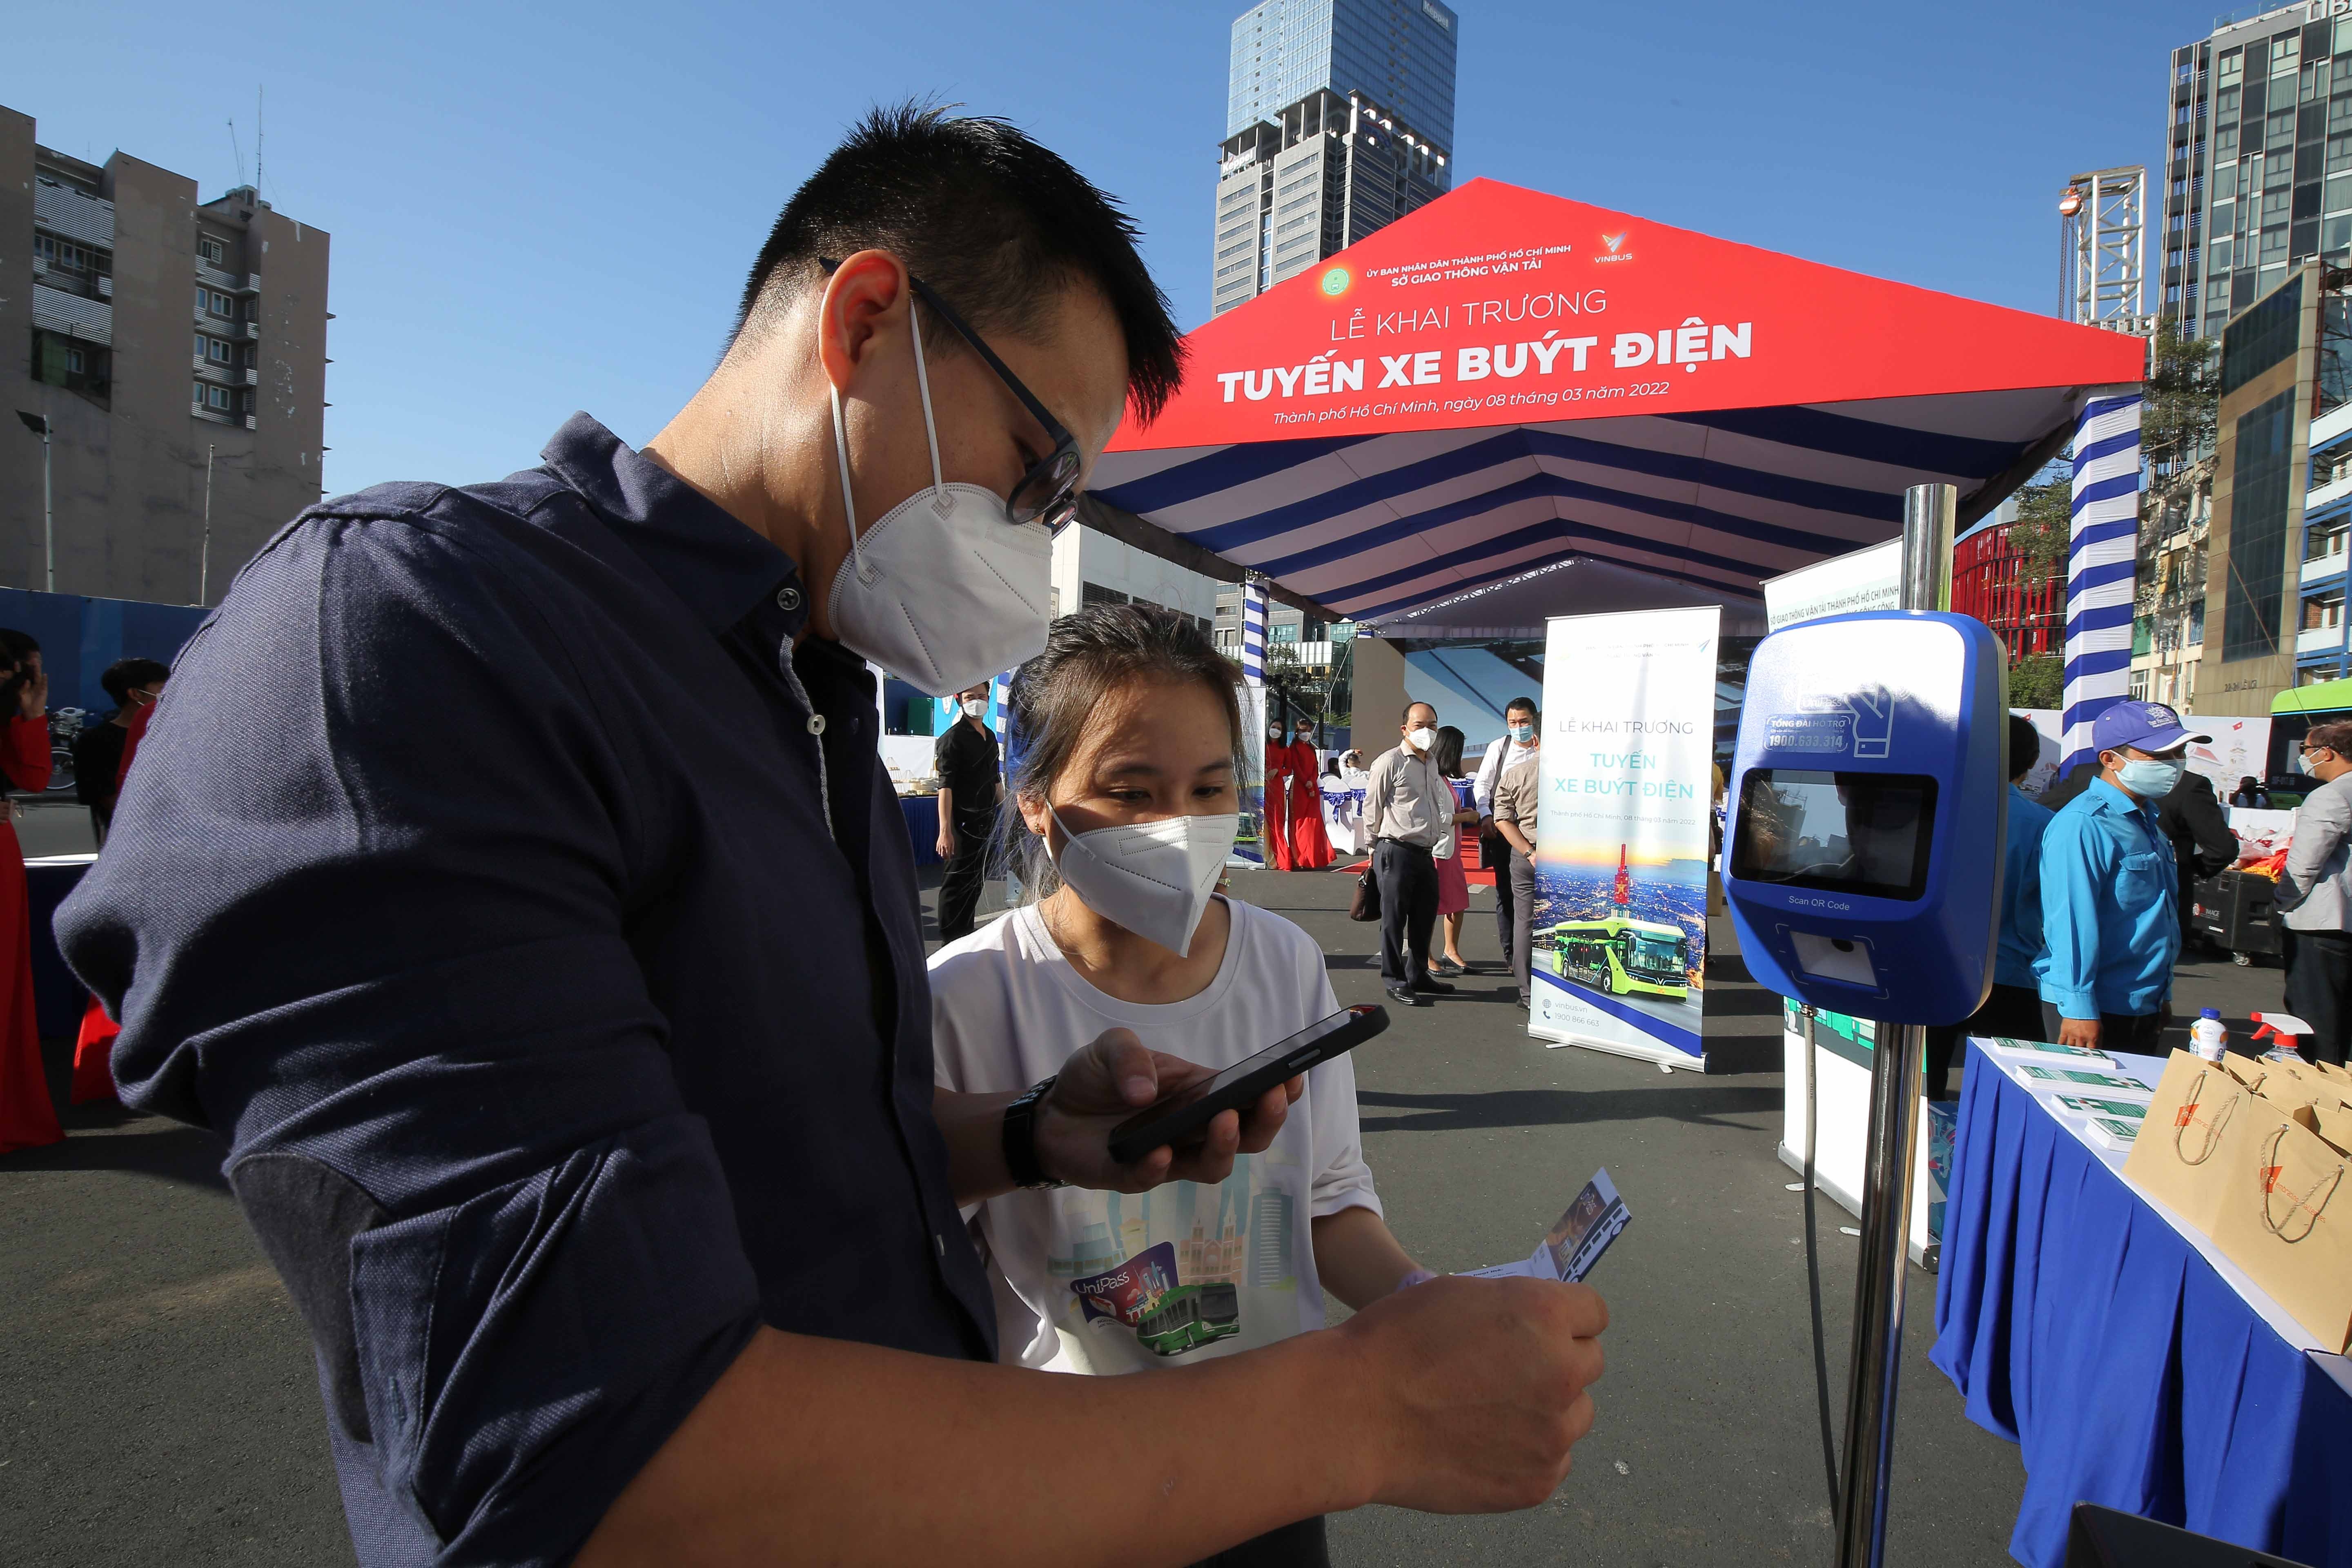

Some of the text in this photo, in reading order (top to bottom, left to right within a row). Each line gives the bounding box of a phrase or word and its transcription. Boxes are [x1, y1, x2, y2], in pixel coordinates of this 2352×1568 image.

[2305, 0, 2352, 24] LIB
[1223, 149, 1253, 173] Keppel
[1366, 244, 1571, 278] ỦY BAN NHÂN DÂN THÀNH PHỐ HỒ CHÍ MINH
[1594, 253, 1633, 263] VINBUS
[1391, 257, 1542, 287] SỞ GIAO THÔNG VẬN TẢI
[1331, 289, 1607, 341] LỄ KHAI TRƯƠNG
[1216, 316, 1753, 403] TUYẾN XE BUÝT ĐIỆN
[1273, 381, 1670, 425] Thành phố Hồ Chí Minh, ngày 08 tháng 03 năm 2022
[1770, 615, 1776, 626] SỞ
[1777, 614, 1788, 624] GIAO
[1788, 609, 1804, 621] THÔNG
[1805, 607, 1818, 617] VẬN
[1827, 598, 1846, 611] THÀNH
[1847, 591, 1860, 606] PHỐ
[1861, 589, 1870, 604] HỒ
[1871, 588, 1881, 601] CHÍ
[1882, 584, 1899, 598] MINH
[1559, 717, 1693, 735] LỄ KHAI TRƯƠNG
[1796, 718, 1811, 727] ĐÀI
[1769, 735, 1843, 747] 1900.633.314
[1590, 749, 1656, 769] TUYẾN
[1554, 777, 1693, 802] XE BUÝT ĐIỆN
[1788, 895, 1850, 911] Scan QR Code
[1555, 1002, 1588, 1013] vinbus.vn
[1555, 1012, 1599, 1027] 1900 866 663
[1076, 1271, 1130, 1294] UniPass
